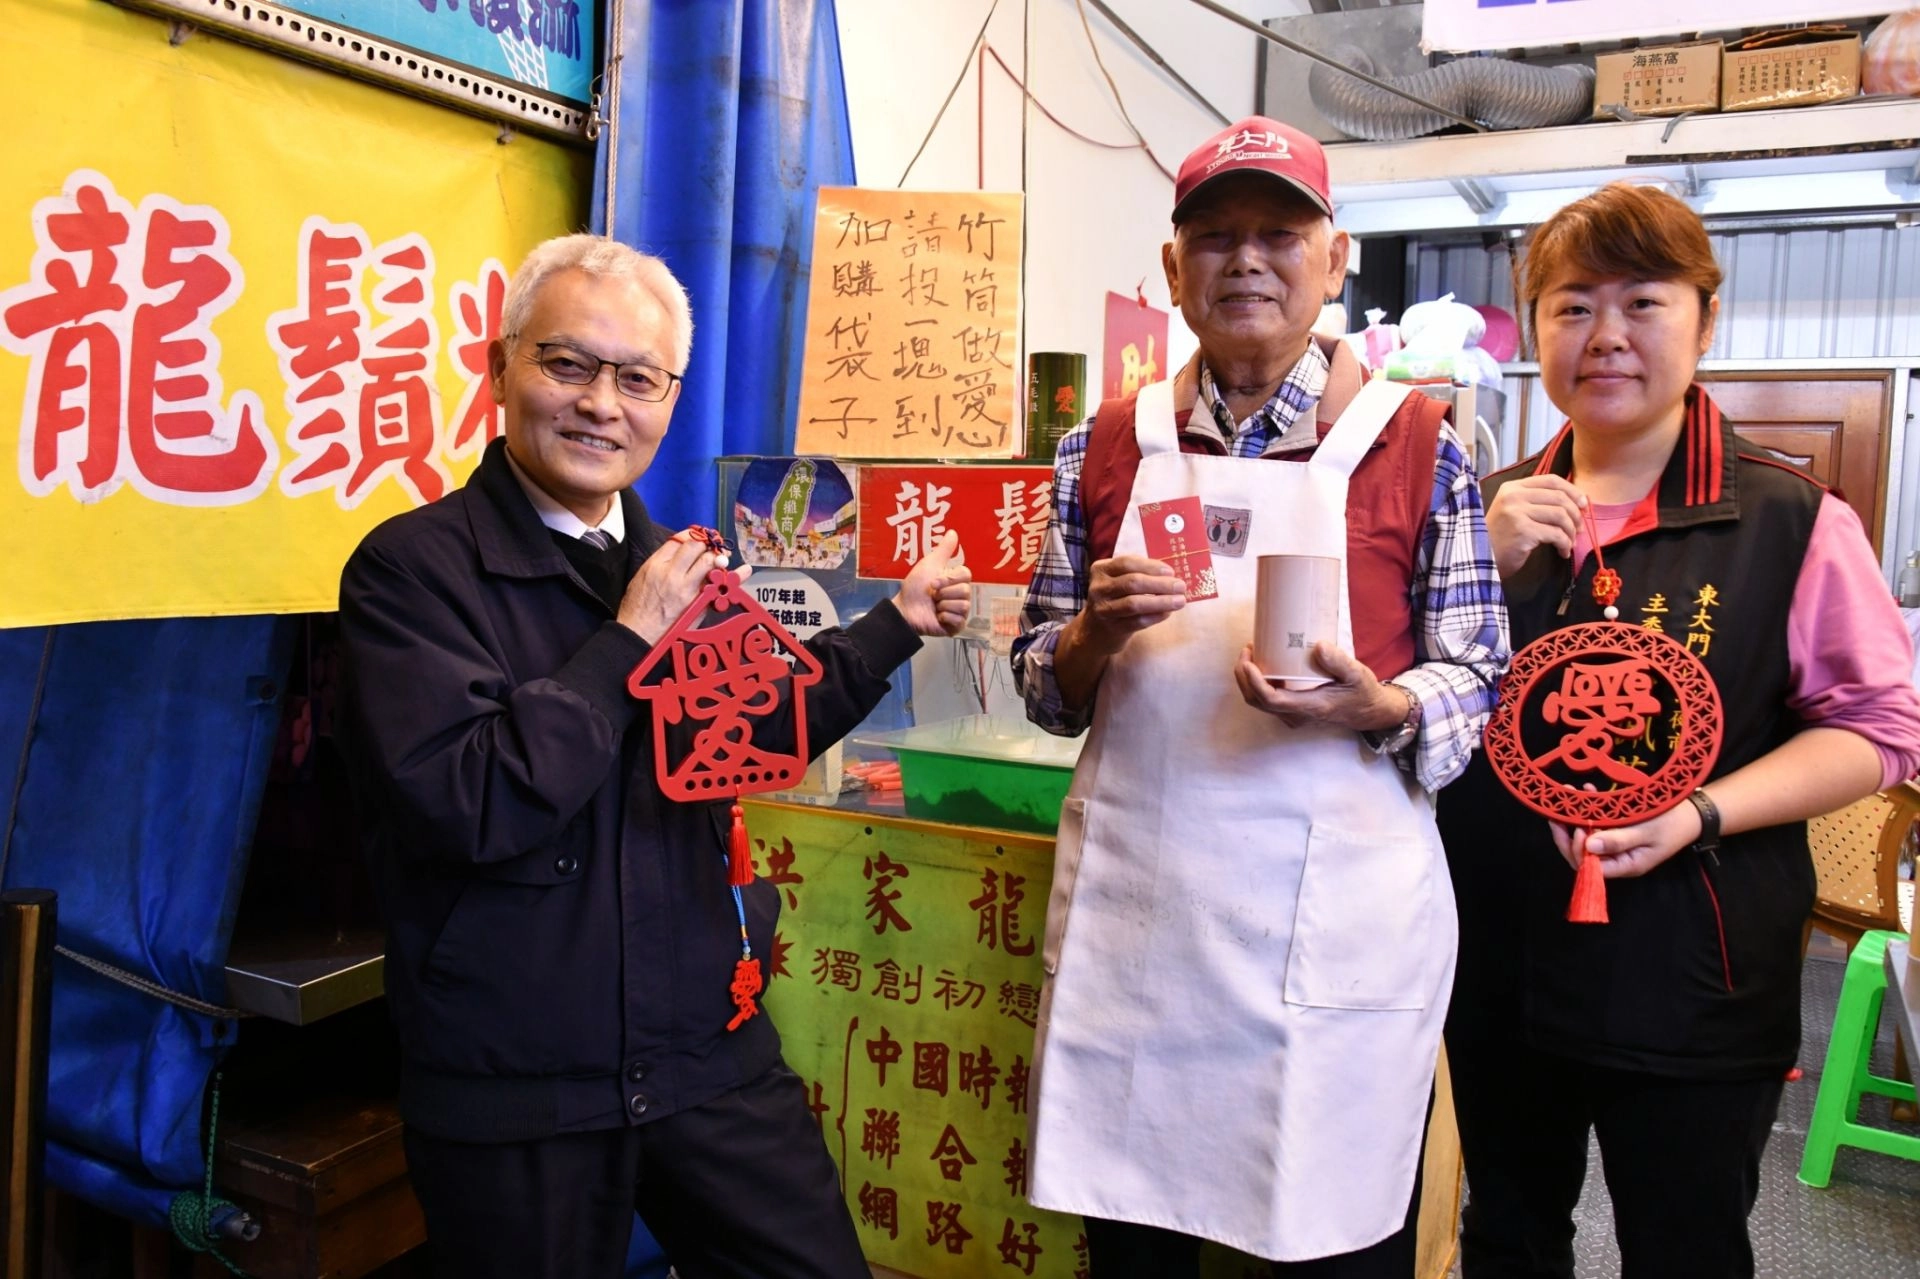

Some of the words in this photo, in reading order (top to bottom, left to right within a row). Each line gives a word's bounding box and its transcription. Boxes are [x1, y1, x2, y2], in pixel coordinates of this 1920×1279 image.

[1632, 51, 1679, 68] 海燕窩
[809, 212, 892, 440] 加購袋子
[893, 210, 950, 440] 請投一塊到
[943, 211, 1012, 447] 竹筒做愛心
[1055, 386, 1076, 413] 愛
[781, 467, 810, 533] 環保攤商
[885, 480, 1051, 572] 龍鬚
[756, 588, 805, 604] 107年起
[1686, 583, 1720, 656] 東大門
[811, 947, 1041, 1029] 獨創初戀
[866, 1026, 1030, 1114] 中國時報
